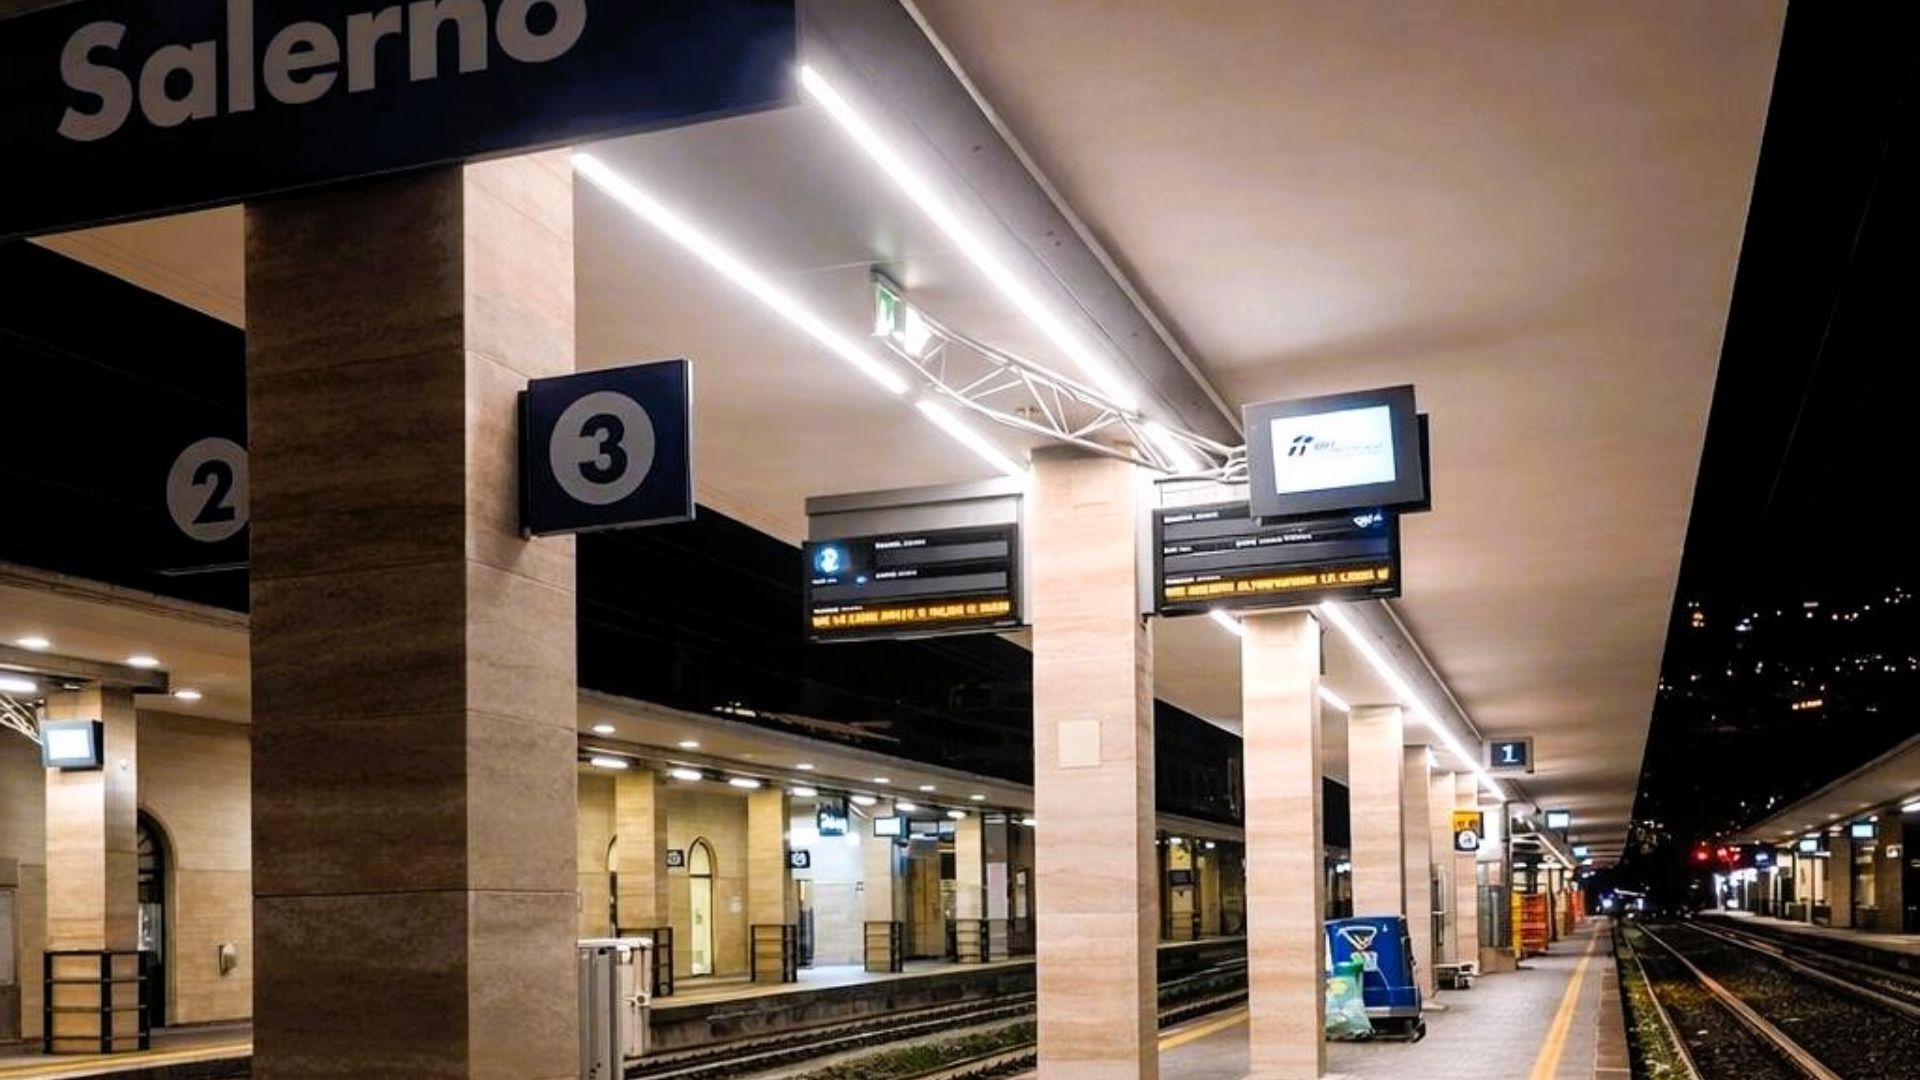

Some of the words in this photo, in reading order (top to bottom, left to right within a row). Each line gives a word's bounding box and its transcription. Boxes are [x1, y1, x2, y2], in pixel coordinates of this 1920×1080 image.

[57, 0, 587, 142] Salerno
[577, 412, 628, 486] 3
[190, 458, 236, 525] 2
[1501, 744, 1518, 762] 1
